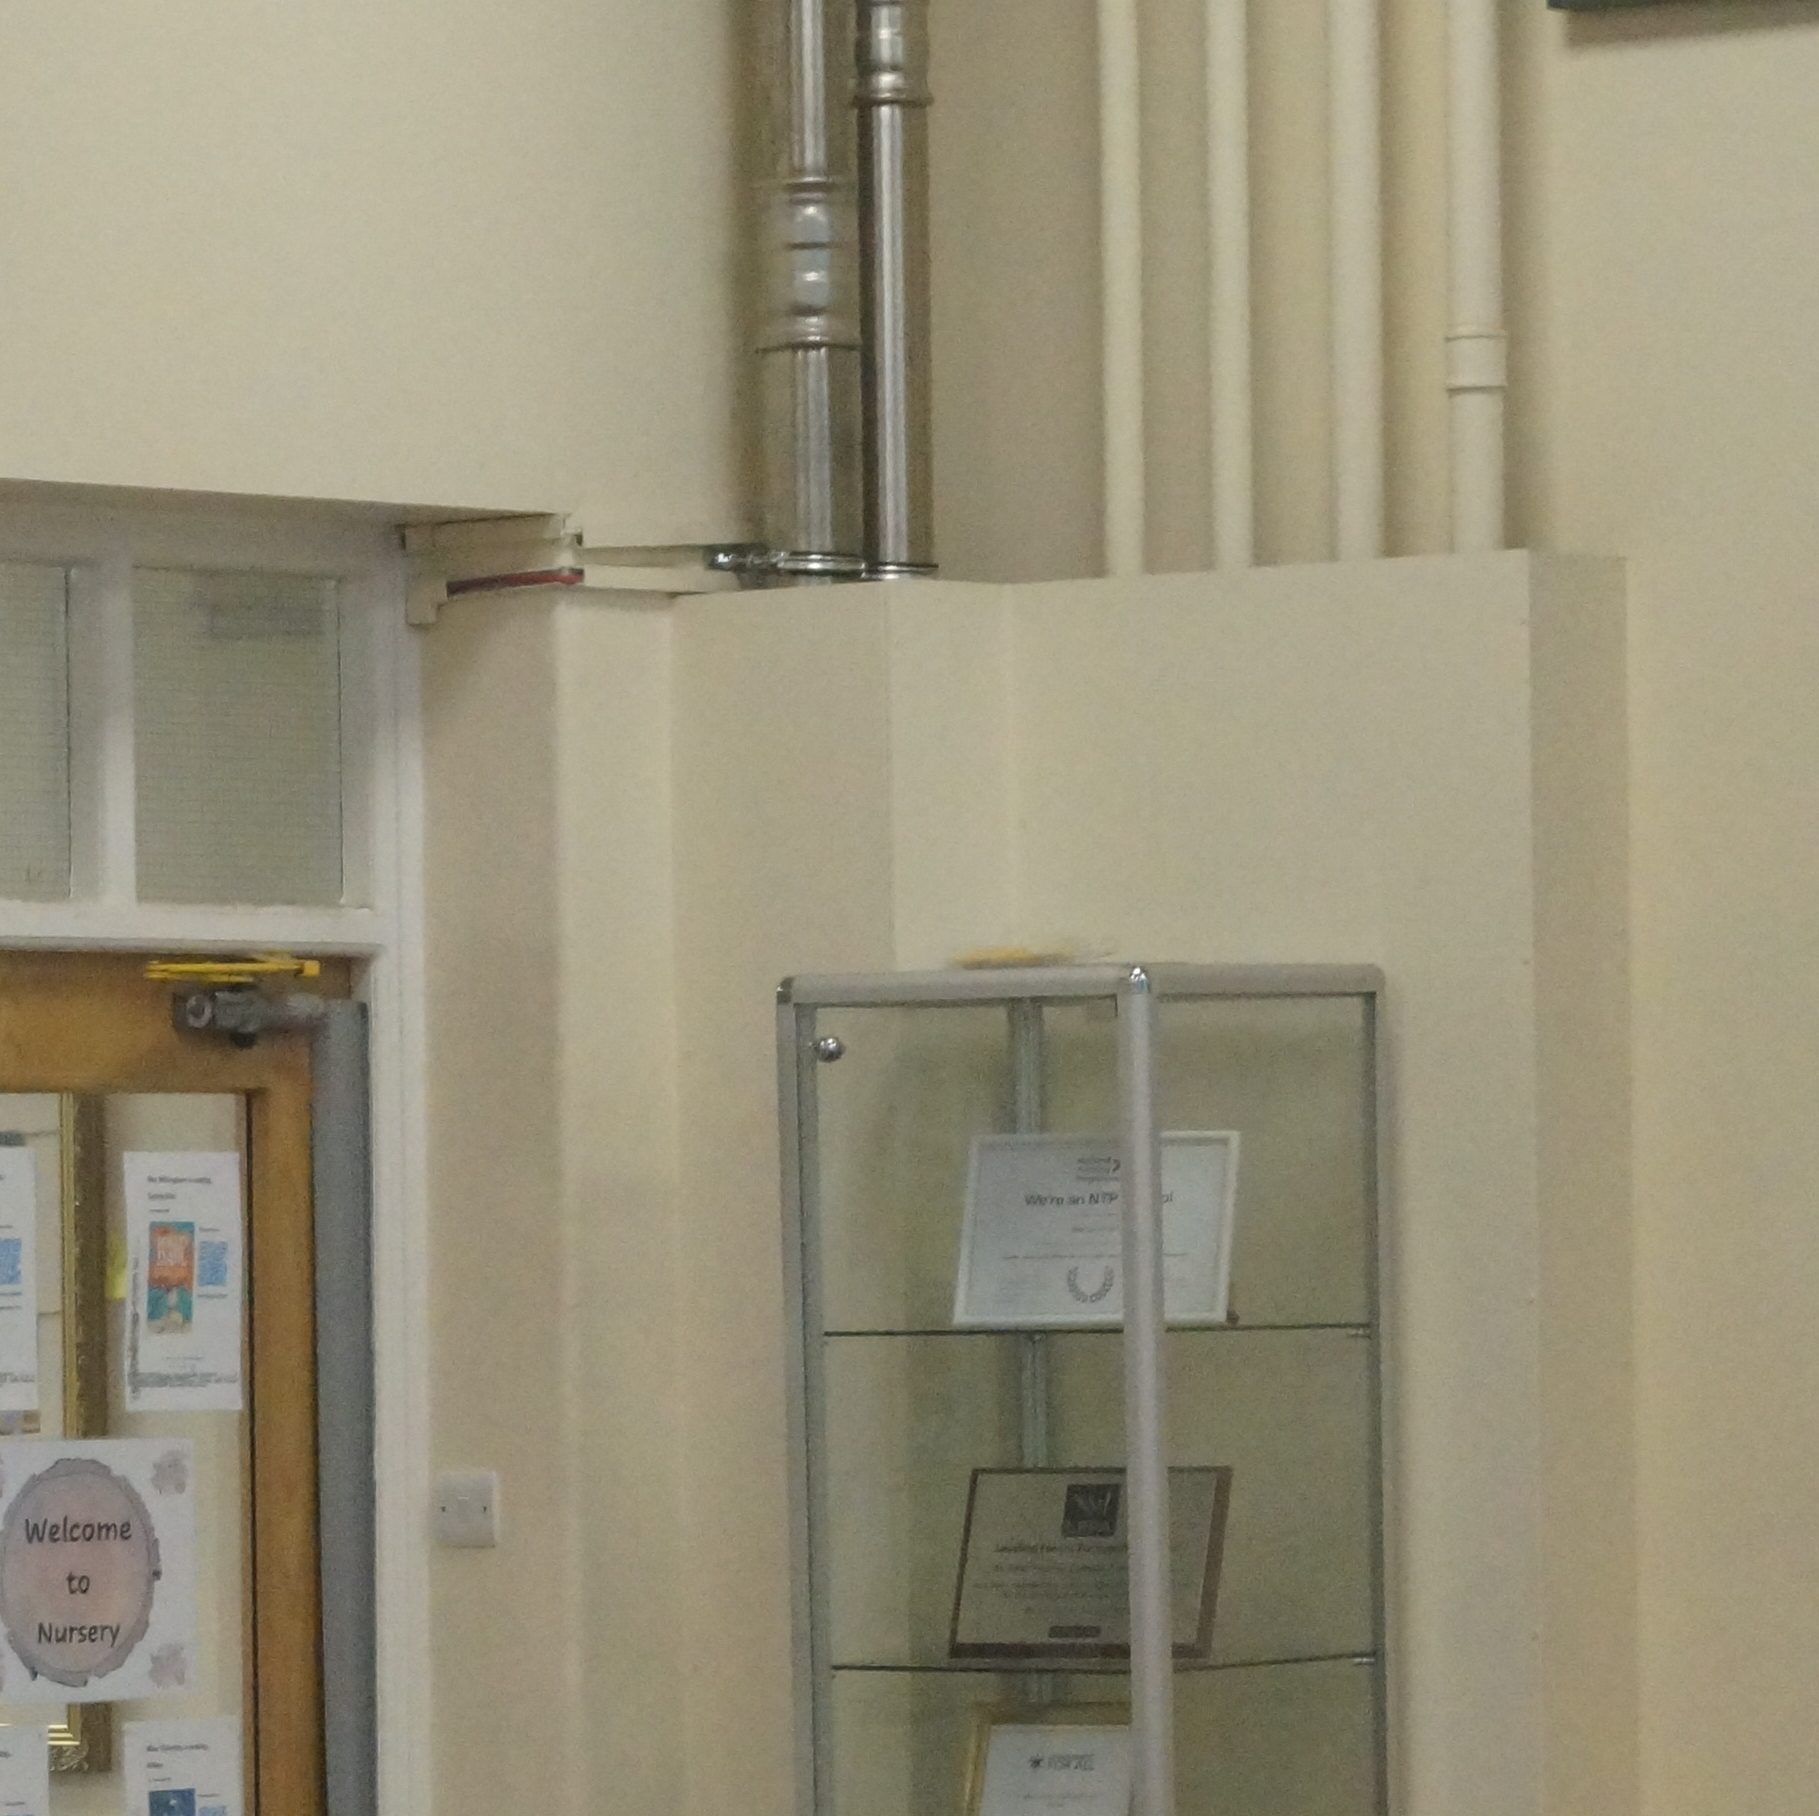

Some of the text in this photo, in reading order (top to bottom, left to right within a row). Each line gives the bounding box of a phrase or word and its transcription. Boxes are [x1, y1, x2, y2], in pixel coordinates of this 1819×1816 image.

[25, 1516, 132, 1543] Welcome
[66, 1571, 91, 1595] to
[37, 1622, 121, 1648] Nursery
